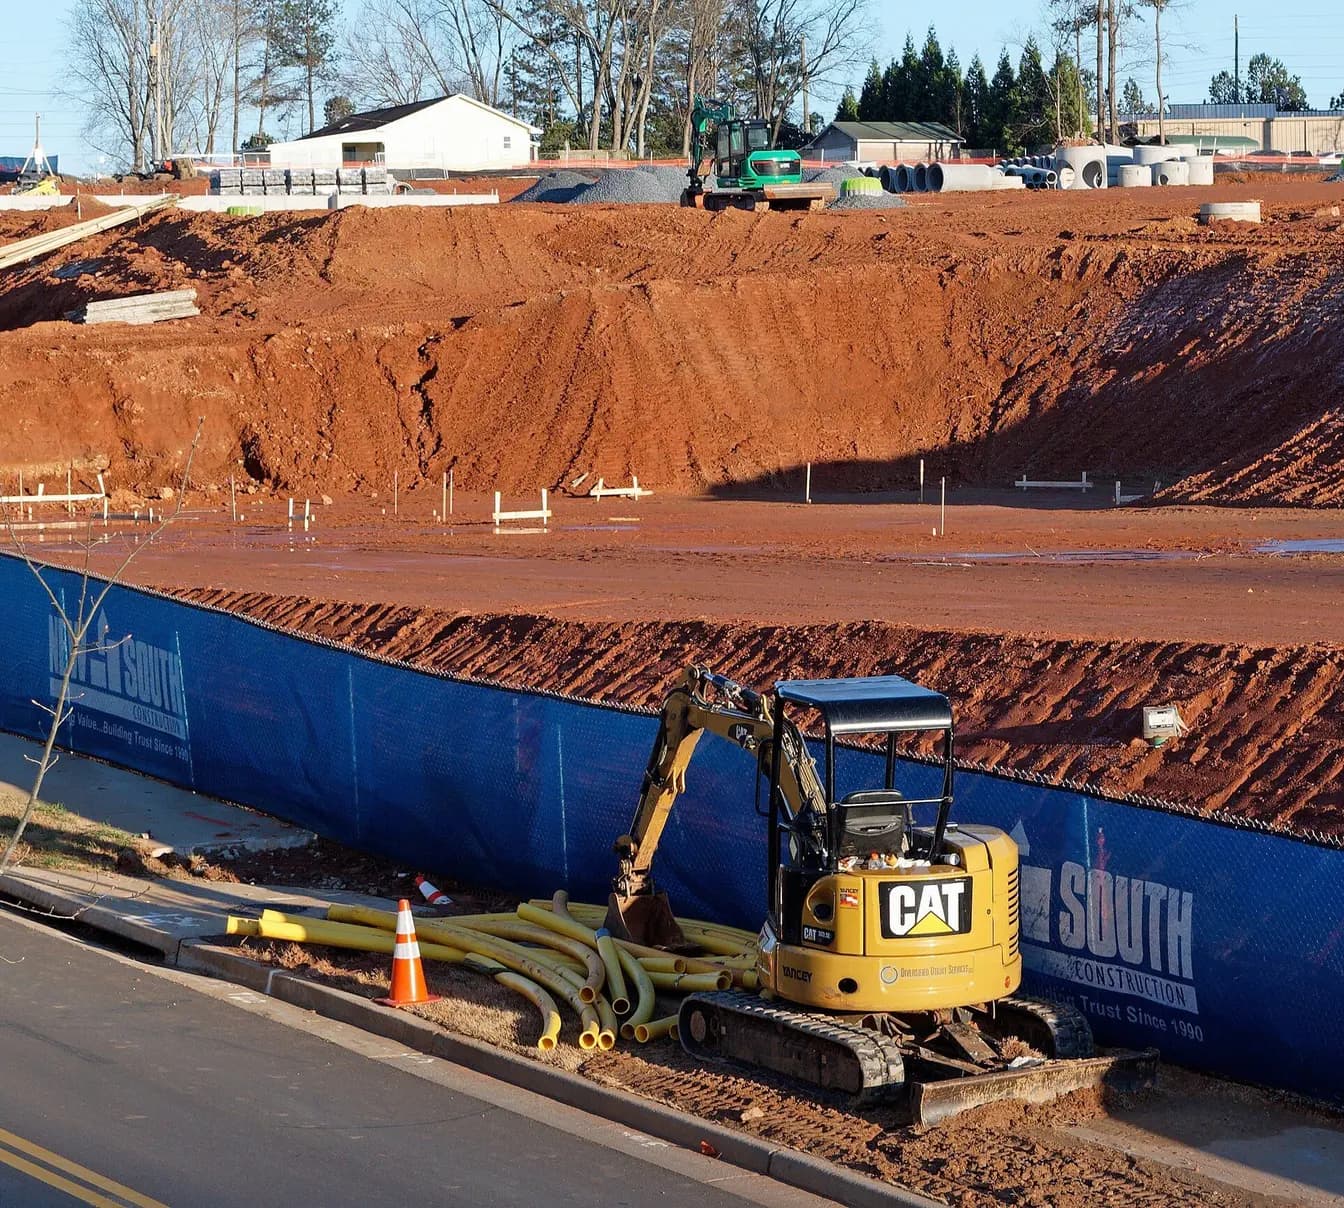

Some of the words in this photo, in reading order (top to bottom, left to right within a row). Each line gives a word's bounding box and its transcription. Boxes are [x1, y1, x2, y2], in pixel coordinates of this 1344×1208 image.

[123, 638, 184, 716] SOUTH
[134, 730, 152, 750] Trust
[154, 737, 174, 757] Since
[889, 882, 965, 936] CAT
[1059, 861, 1194, 981] SOUTH
[804, 927, 816, 942] CAT
[783, 964, 813, 984] YANCEY
[1075, 957, 1187, 1008] CONSTRUCTION
[1080, 994, 1122, 1021] Trust
[1127, 1005, 1167, 1031] Since
[1171, 1018, 1204, 1043] 1990
